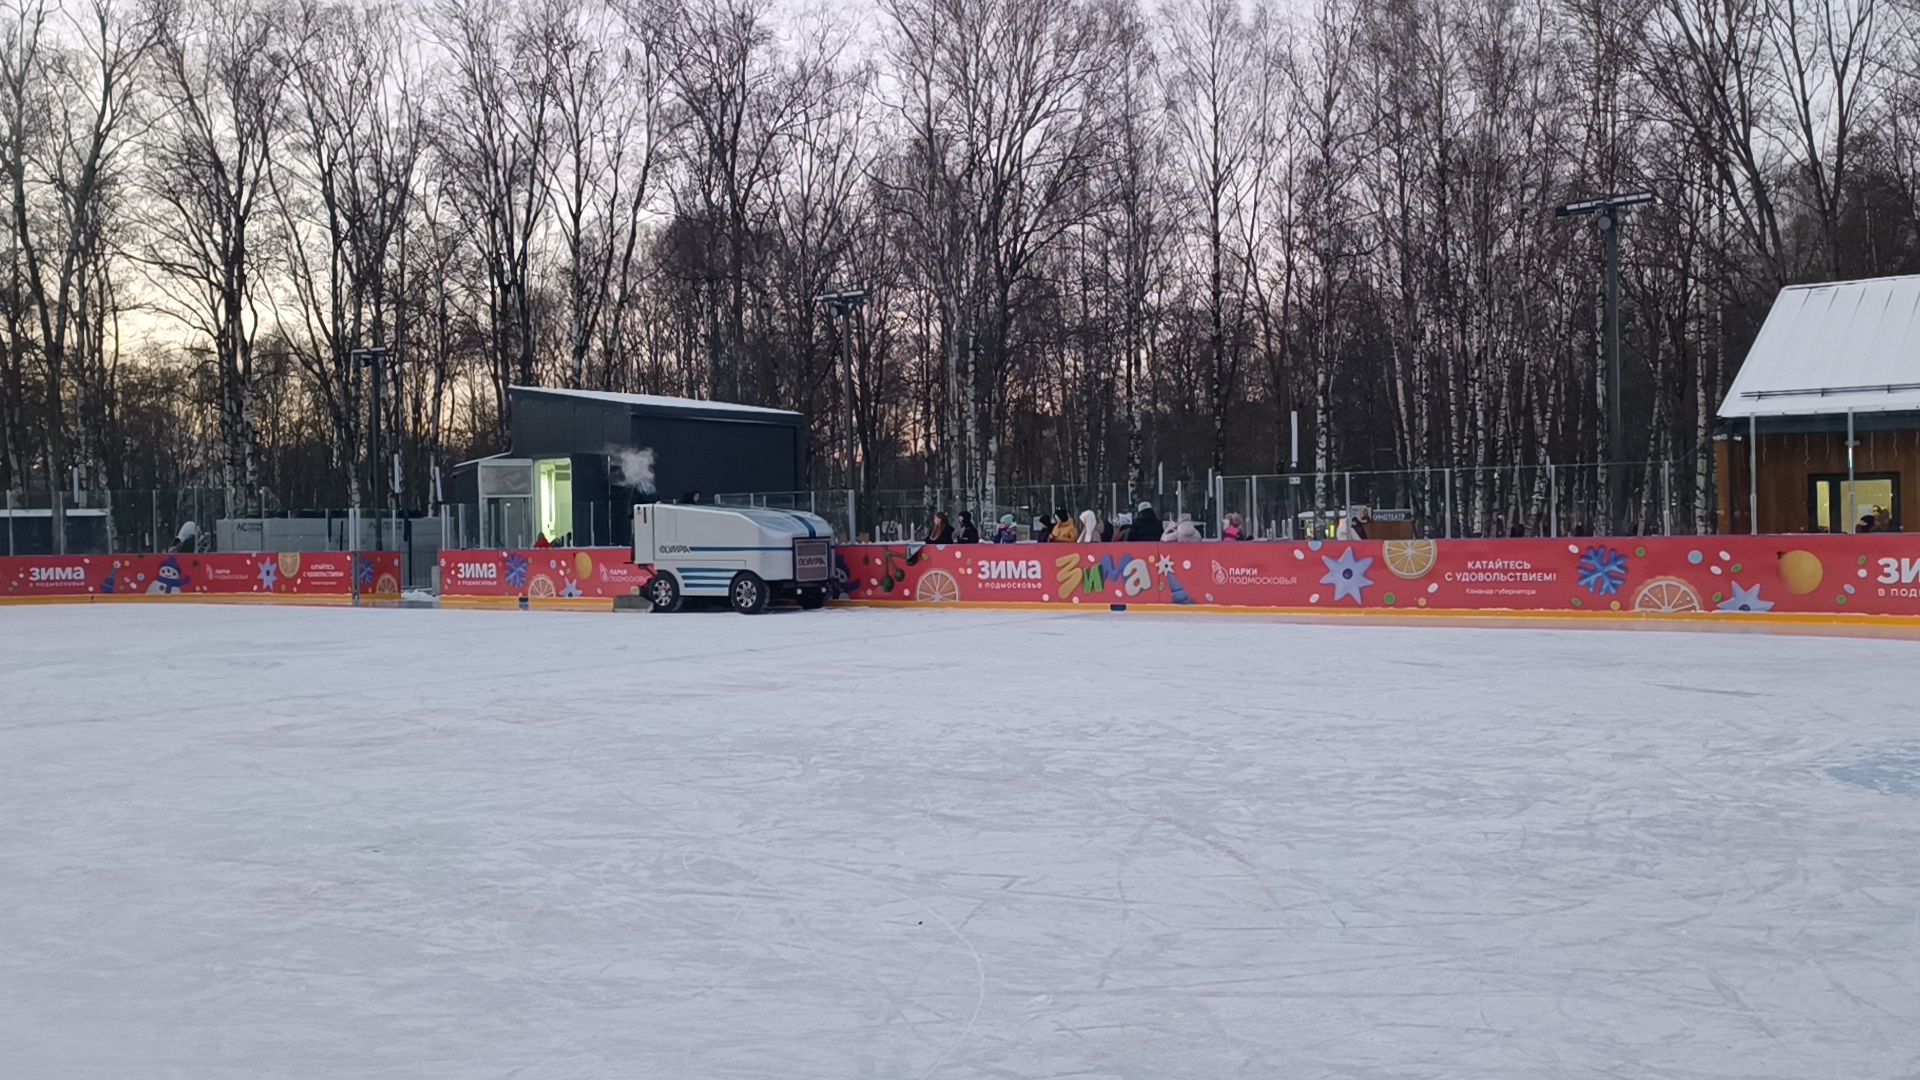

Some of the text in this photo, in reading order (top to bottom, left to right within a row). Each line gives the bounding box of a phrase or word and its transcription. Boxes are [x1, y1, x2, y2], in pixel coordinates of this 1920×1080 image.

[1467, 558, 1531, 570] КАТАЙТЕСЬ
[1229, 567, 1258, 576] ПАРКИ
[1877, 557, 1920, 584] зи
[1229, 576, 1297, 585] ПОДМОСКОВЬЯ
[1444, 572, 1557, 582] С УДОВОЛЬСТВИЕМ!
[985, 582, 1042, 590] подмосковье
[1878, 588, 1885, 597] в
